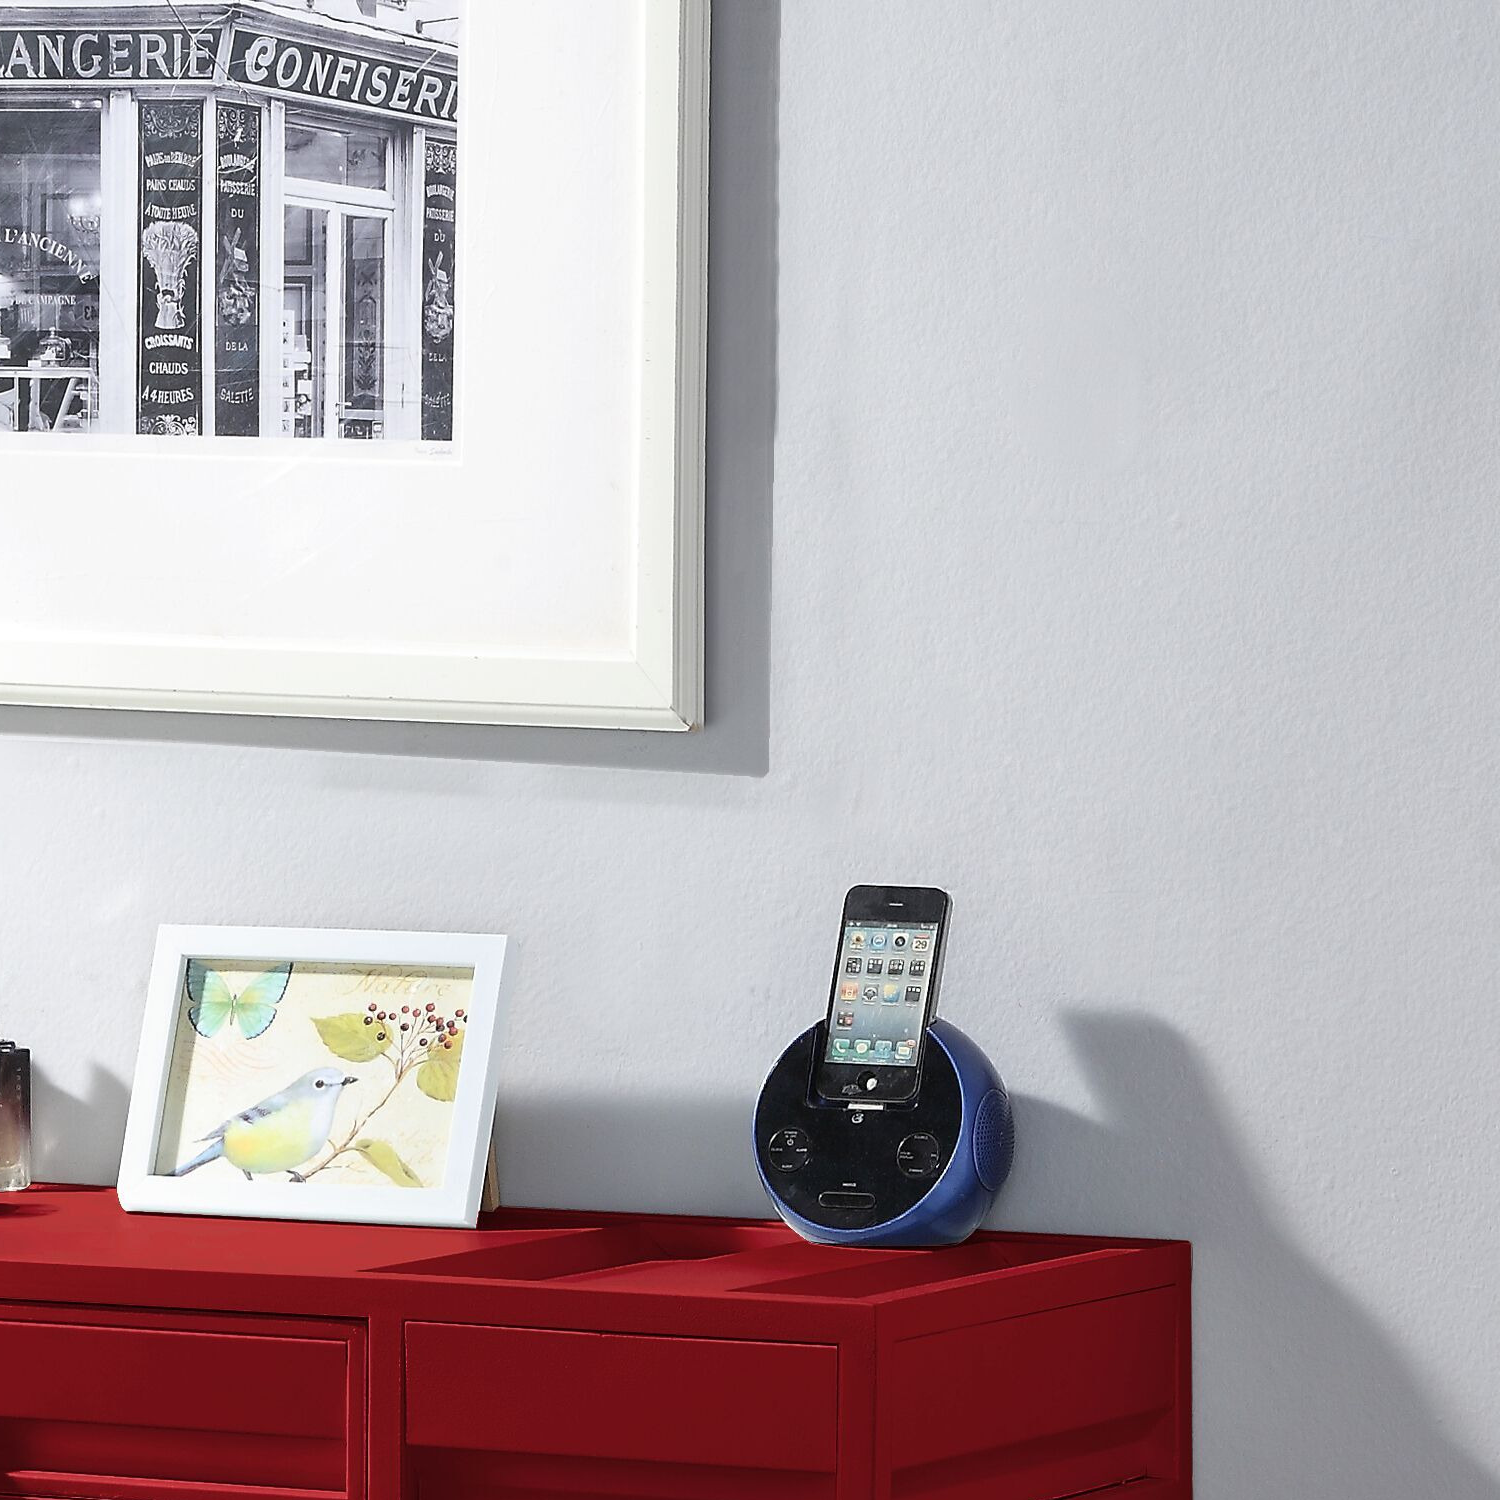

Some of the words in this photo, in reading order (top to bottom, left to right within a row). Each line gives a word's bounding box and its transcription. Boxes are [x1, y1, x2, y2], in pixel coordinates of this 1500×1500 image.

[245, 36, 457, 119] CONFISERI
[146, 179, 167, 191] PAINS
[169, 179, 196, 191] CHAUDS
[152, 204, 172, 220] TOUTE
[172, 204, 197, 220] HEURE
[231, 208, 244, 218] DU
[434, 232, 445, 242] DU
[144, 334, 194, 350] CROISSANTS
[226, 341, 237, 351] DE
[238, 342, 249, 351] LA
[149, 362, 189, 375] CHAUDS
[158, 388, 194, 404] HEURES
[914, 940, 928, 950] 29
